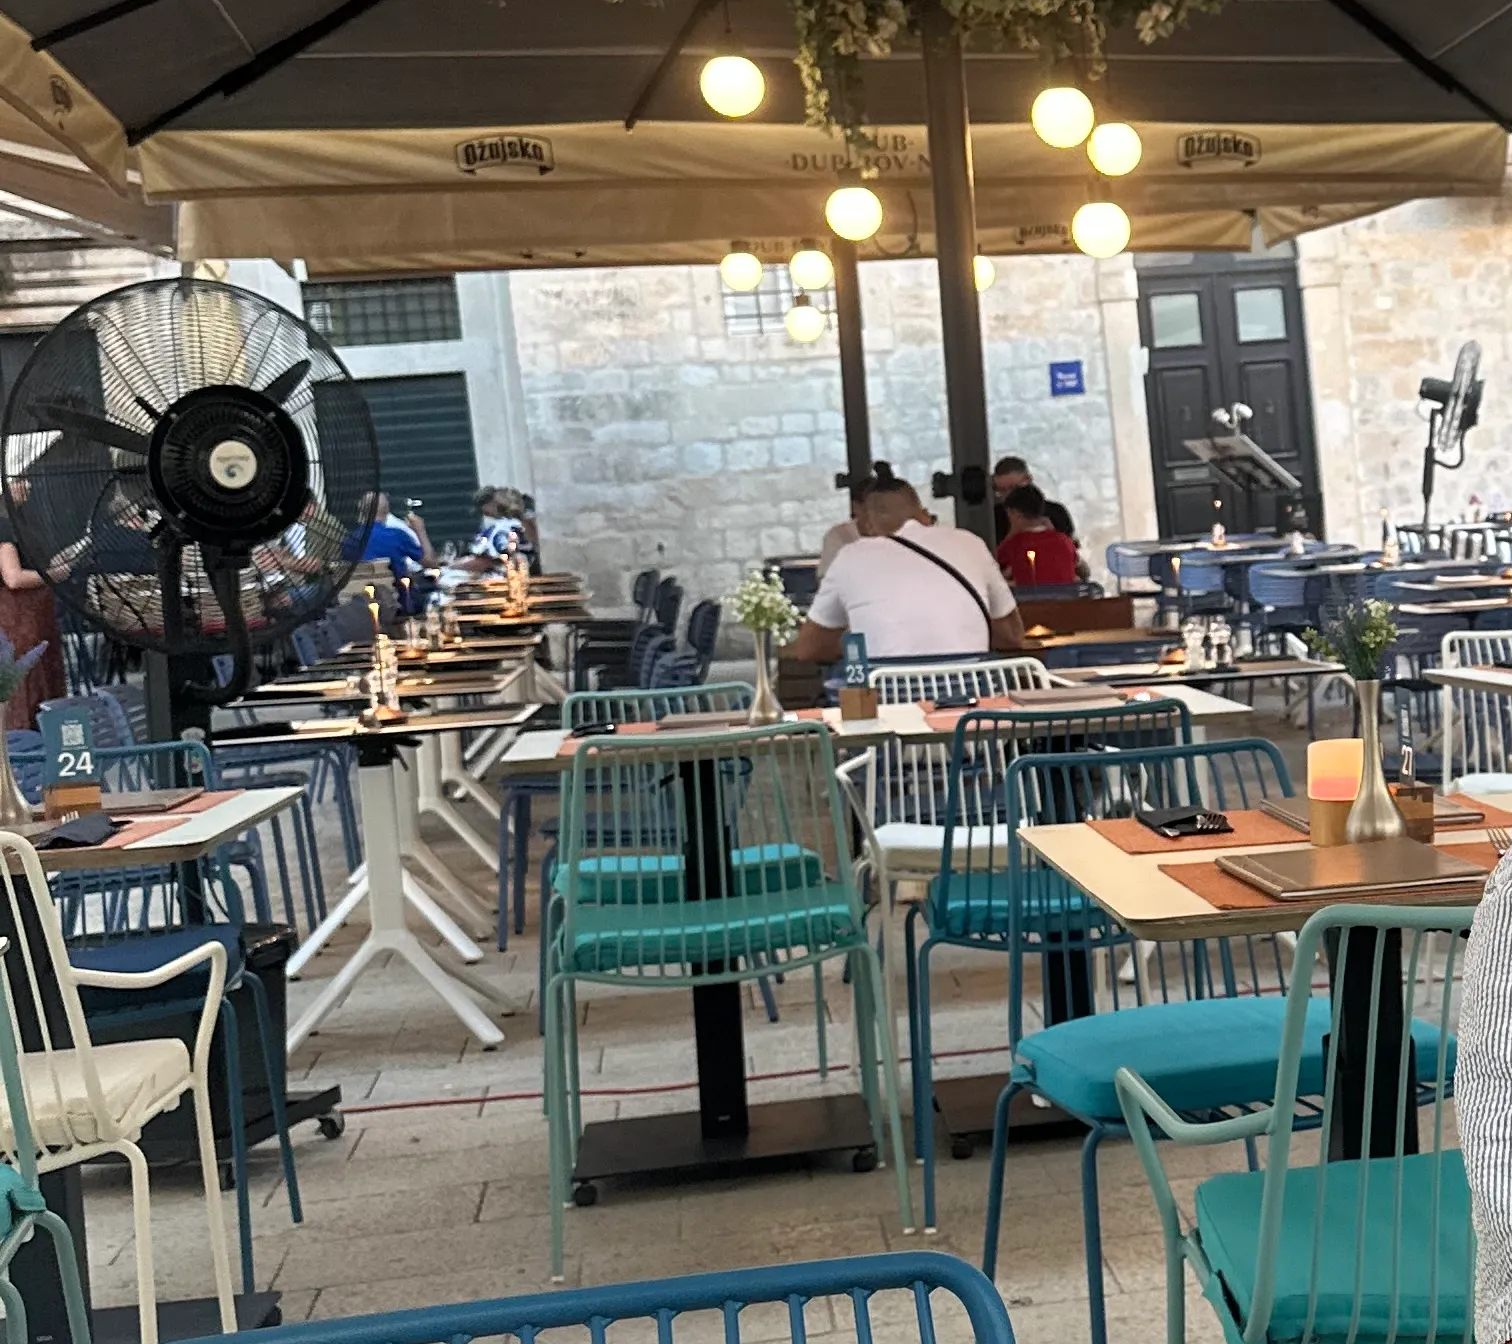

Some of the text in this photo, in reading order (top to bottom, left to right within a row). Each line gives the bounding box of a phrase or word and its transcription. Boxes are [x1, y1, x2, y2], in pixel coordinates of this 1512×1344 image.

[846, 664, 865, 684] 23
[57, 751, 95, 777] 24
[1401, 744, 1413, 776] 27
